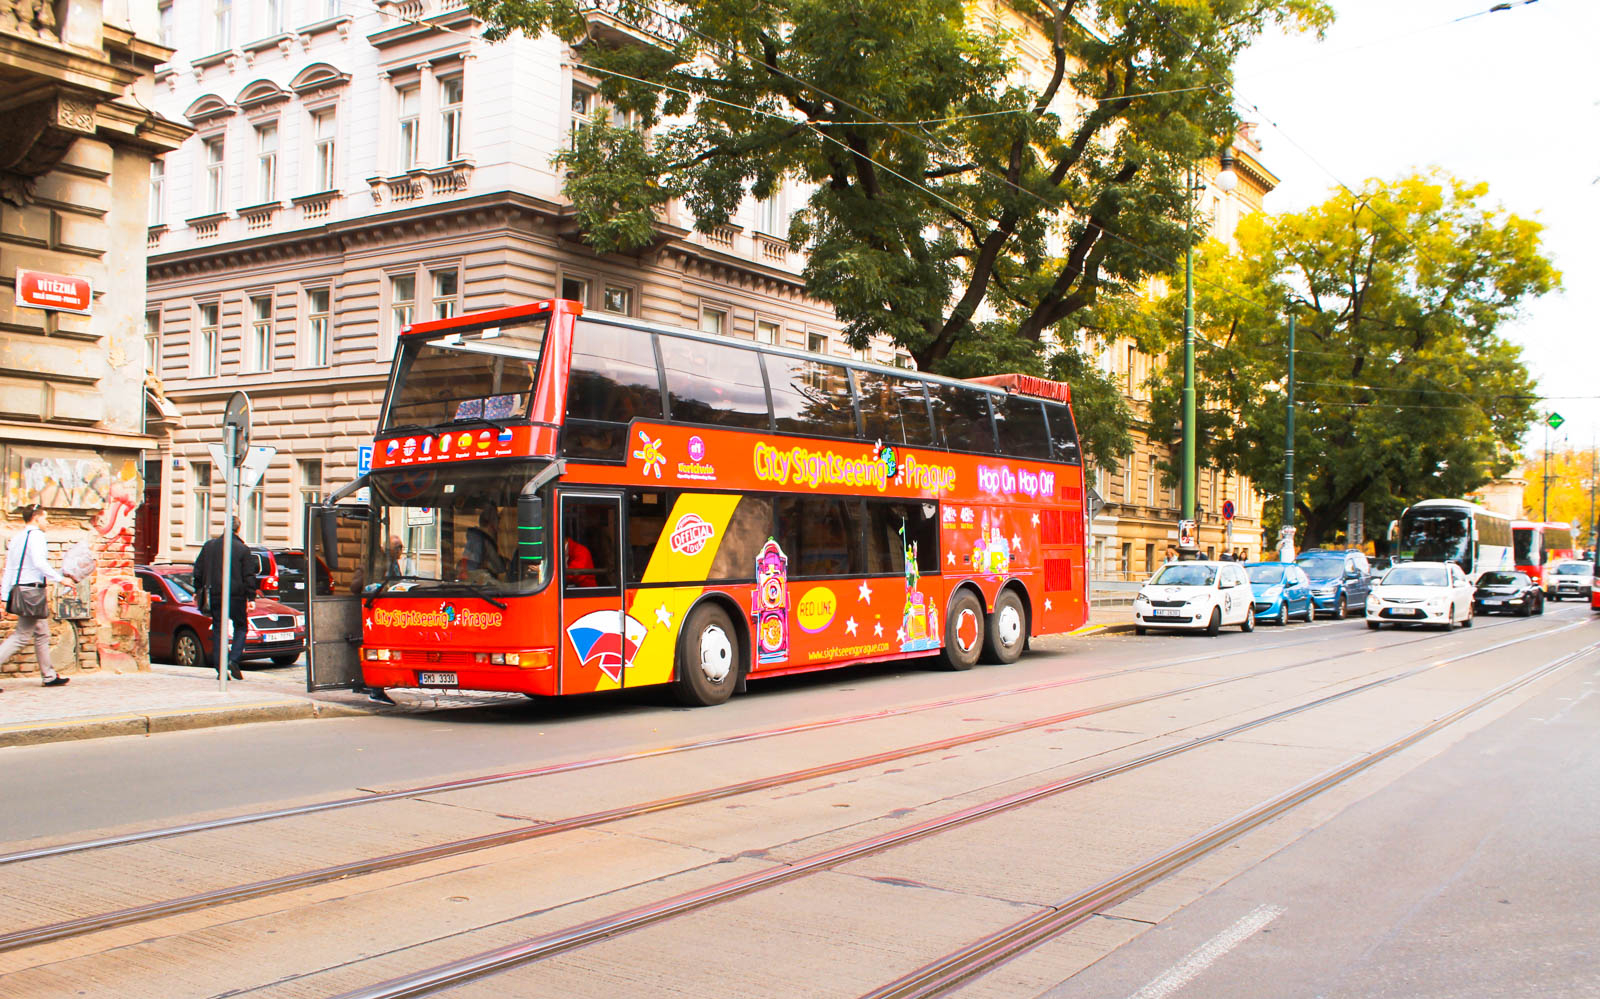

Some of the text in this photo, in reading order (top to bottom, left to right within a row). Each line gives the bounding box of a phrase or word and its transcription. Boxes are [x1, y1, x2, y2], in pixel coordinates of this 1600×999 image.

[905, 454, 956, 495] Prague
[978, 466, 1055, 497] Hop On Hop Off
[674, 524, 713, 547] OFFICIAL
[461, 608, 503, 629] Prague
[800, 600, 832, 617] RED LINE
[423, 673, 455, 684] 5M3 3330
